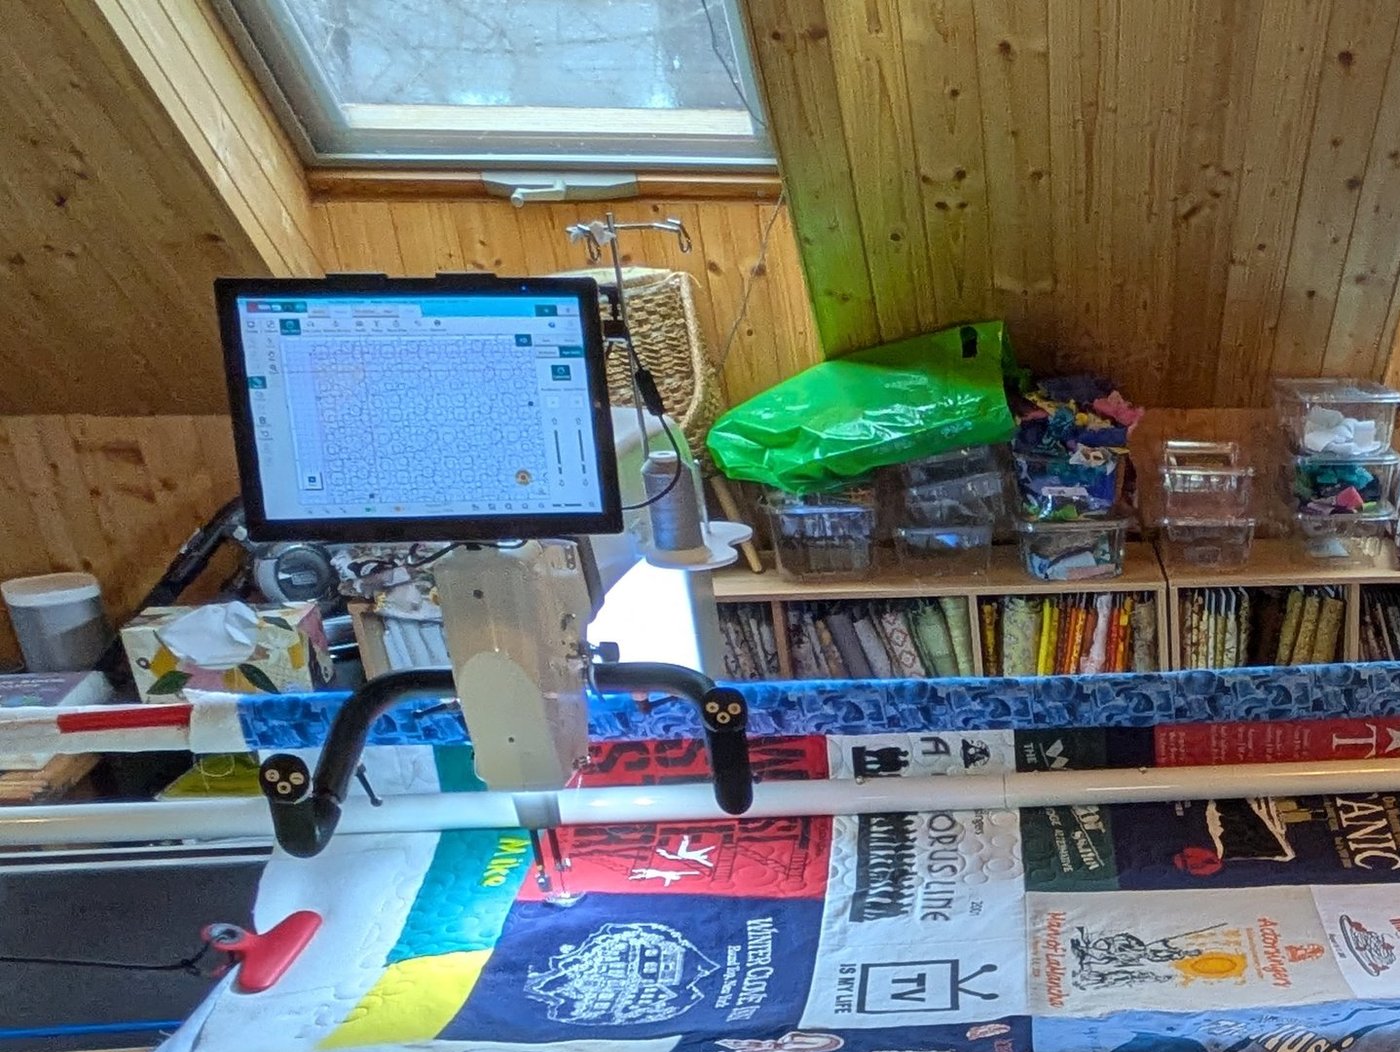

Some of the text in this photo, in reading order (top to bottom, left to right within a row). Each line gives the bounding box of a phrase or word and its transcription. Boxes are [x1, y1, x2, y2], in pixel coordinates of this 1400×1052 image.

[1024, 742, 1038, 764] THE
[480, 837, 532, 887] Mike
[920, 880, 960, 922] LINE
[744, 917, 774, 966] WINTER
[833, 963, 857, 1015] IS MY LIFE
[890, 973, 926, 1002] TV
